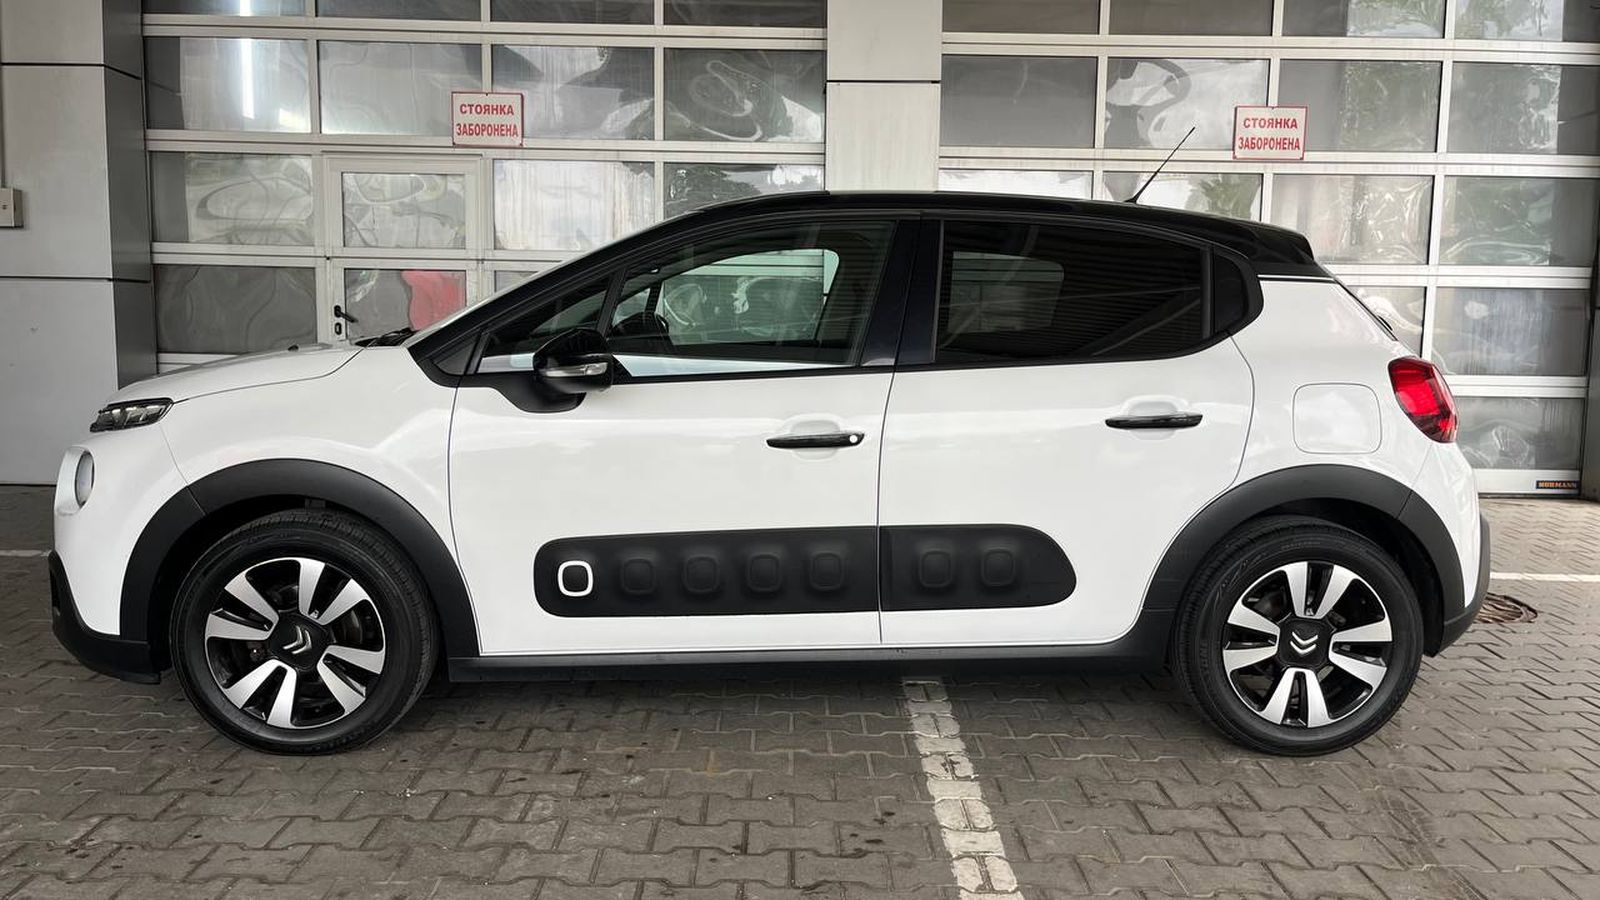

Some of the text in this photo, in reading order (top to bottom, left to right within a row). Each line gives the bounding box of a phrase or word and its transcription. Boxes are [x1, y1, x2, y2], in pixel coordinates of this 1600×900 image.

[459, 103, 514, 115] СТОЯНКА
[1243, 117, 1298, 129] СТОЯНКА
[456, 123, 519, 137] ЗАБОРОНЕНА
[1238, 136, 1301, 150] ЗАБОРОНЕНА
